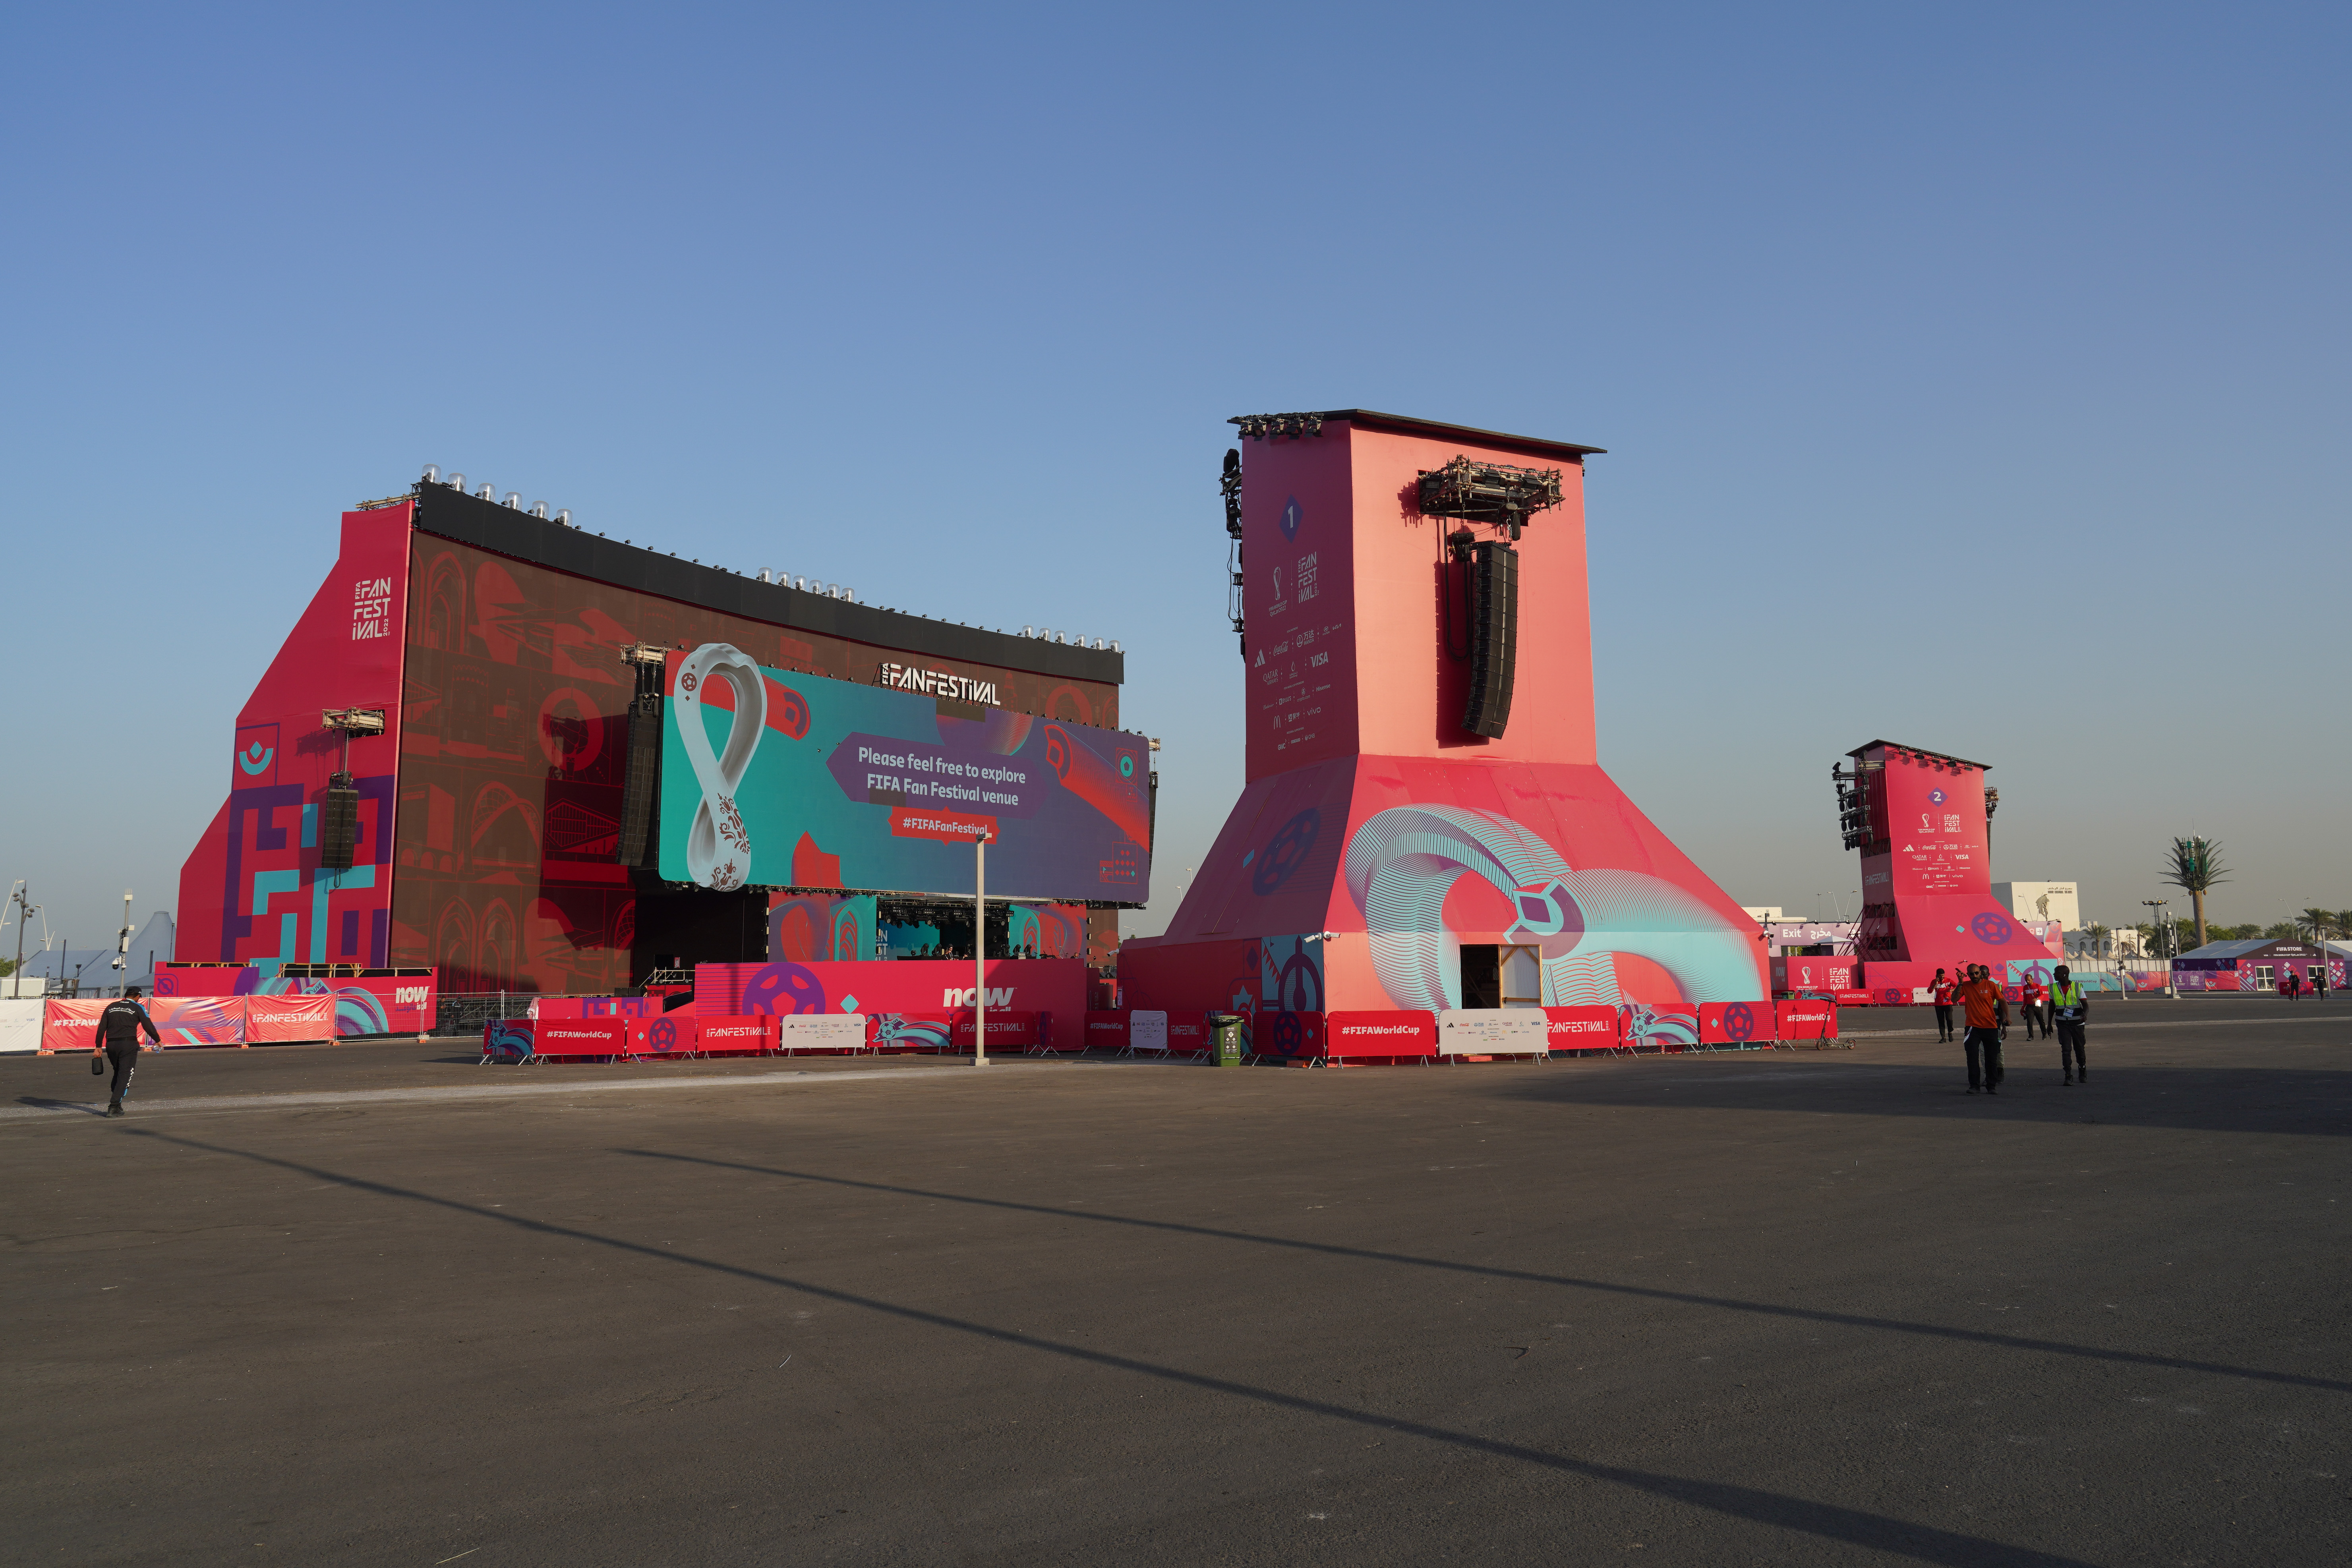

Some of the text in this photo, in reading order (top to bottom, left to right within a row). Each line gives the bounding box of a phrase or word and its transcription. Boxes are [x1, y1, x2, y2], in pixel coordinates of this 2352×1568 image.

[1288, 505, 1293, 528] 1
[1301, 551, 1317, 571] FAN
[1298, 566, 1317, 588] FEST
[361, 577, 391, 599] FAN
[354, 597, 391, 620] FEST
[1304, 629, 1314, 641] 万达
[1310, 651, 1329, 668] VISA
[1263, 669, 1278, 682] QATAR
[1307, 707, 1321, 716] vivo
[859, 746, 1026, 785] Please feel free to explore
[867, 773, 1019, 806] FIFA Fan Festival venue
[1934, 791, 1942, 801] 2
[903, 817, 988, 835] #FIFAFanFestival
[1783, 928, 1801, 938] Exit
[1810, 928, 1831, 940] مخرج
[313, 982, 322, 992] LIVE
[396, 986, 429, 1003] now
[943, 987, 1014, 1007] now
[547, 1031, 612, 1040] #FIFAWorldCup
[1090, 1023, 1123, 1031] #FIFAWorldCup
[1342, 1025, 1420, 1035] #FIFAWorldCup
